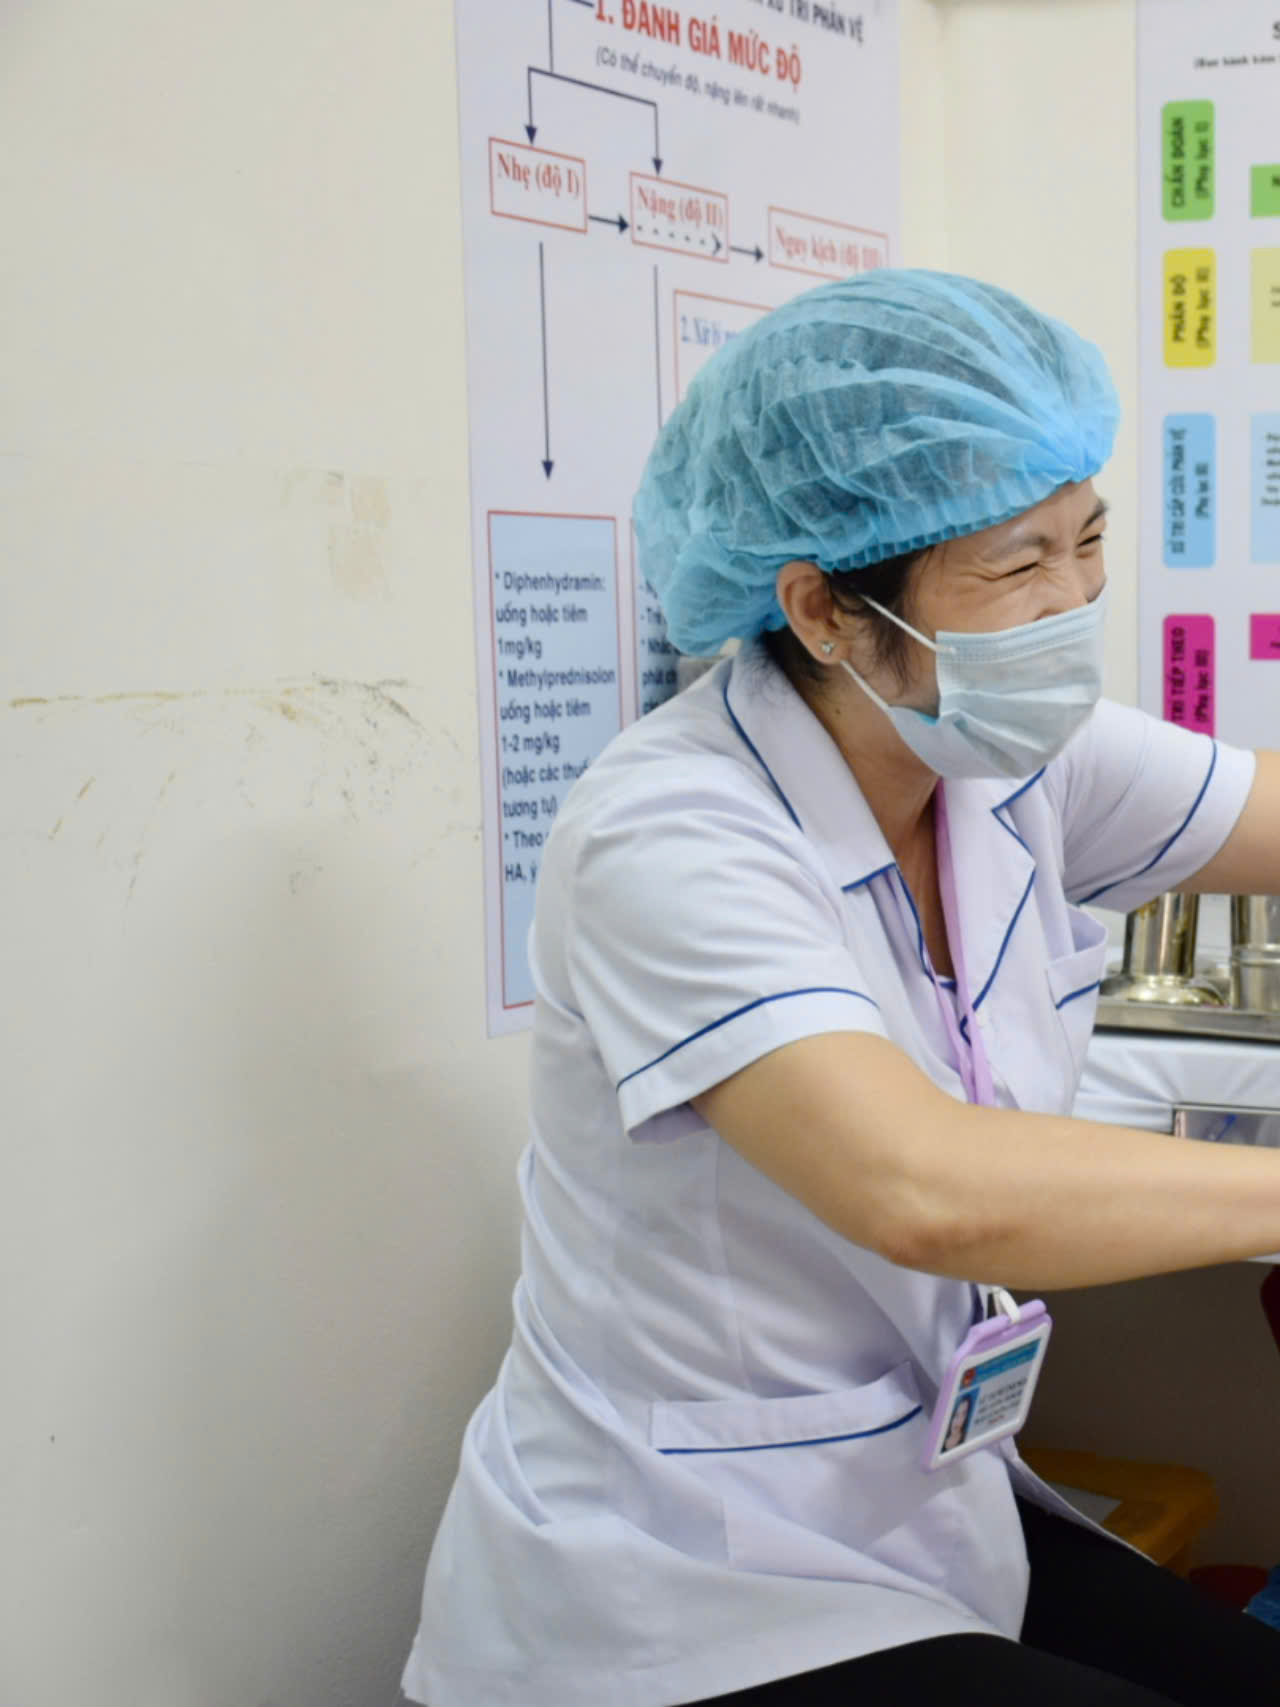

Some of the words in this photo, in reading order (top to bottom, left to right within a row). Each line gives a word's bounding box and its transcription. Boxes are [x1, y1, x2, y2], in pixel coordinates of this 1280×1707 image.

[687, 15, 721, 60] GIÁ
[727, 30, 770, 77] MỨC
[775, 44, 801, 93] ĐỘ
[497, 152, 531, 183] Nhẹ
[496, 604, 527, 627] uống
[531, 604, 561, 626] hoặc
[562, 604, 588, 623] tiêm
[500, 702, 531, 724] uống
[534, 701, 564, 723] hoặc
[565, 699, 591, 718] tiêm
[539, 763, 560, 782] các
[512, 830, 543, 848] Theo
